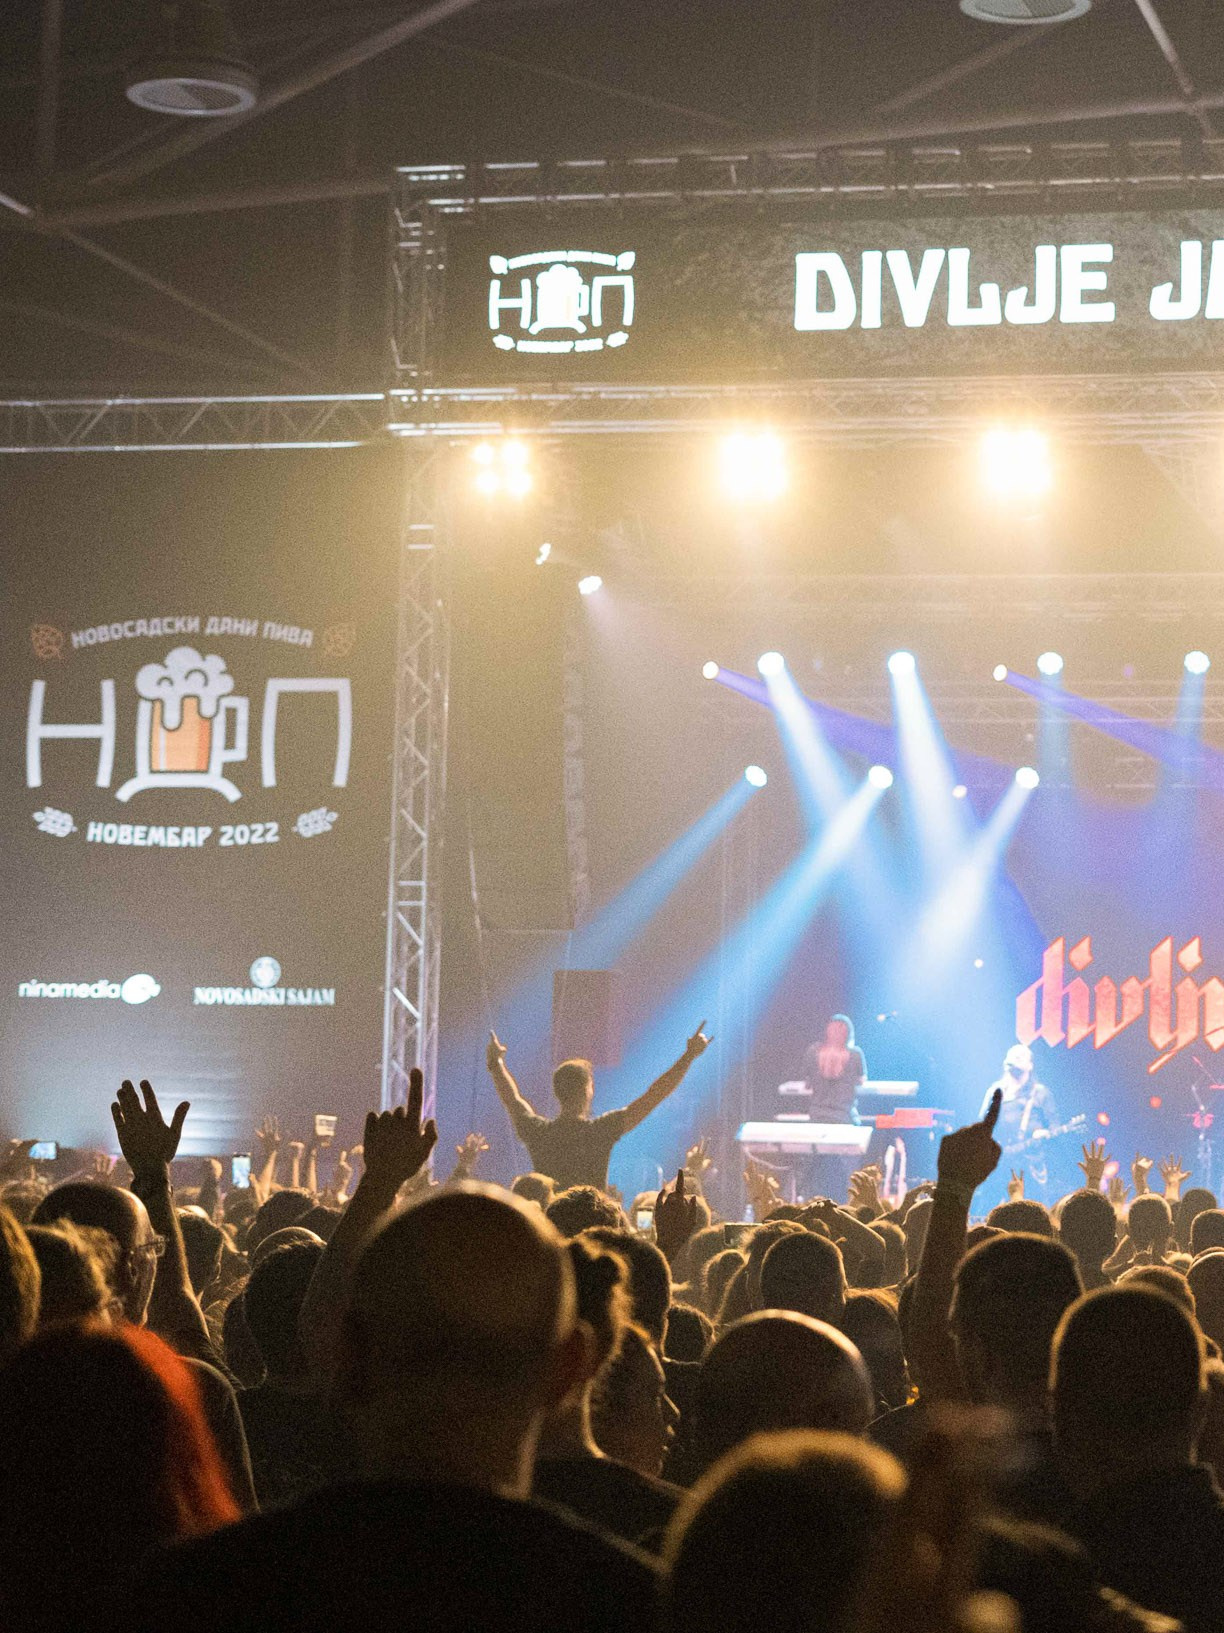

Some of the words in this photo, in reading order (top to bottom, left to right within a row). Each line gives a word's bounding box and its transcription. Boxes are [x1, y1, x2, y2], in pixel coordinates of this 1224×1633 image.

[794, 243, 1116, 331] DIVLJE
[71, 615, 201, 649] НОВОСАДСКИ
[204, 615, 259, 637] ДАНИ
[262, 621, 315, 649] ПИВА
[86, 821, 212, 848] НОВЕМБАР
[218, 821, 280, 847] 2022
[18, 978, 122, 999] ninamedia
[193, 986, 285, 1006] NOVOSADSKI
[286, 987, 336, 1006] SAJAM
